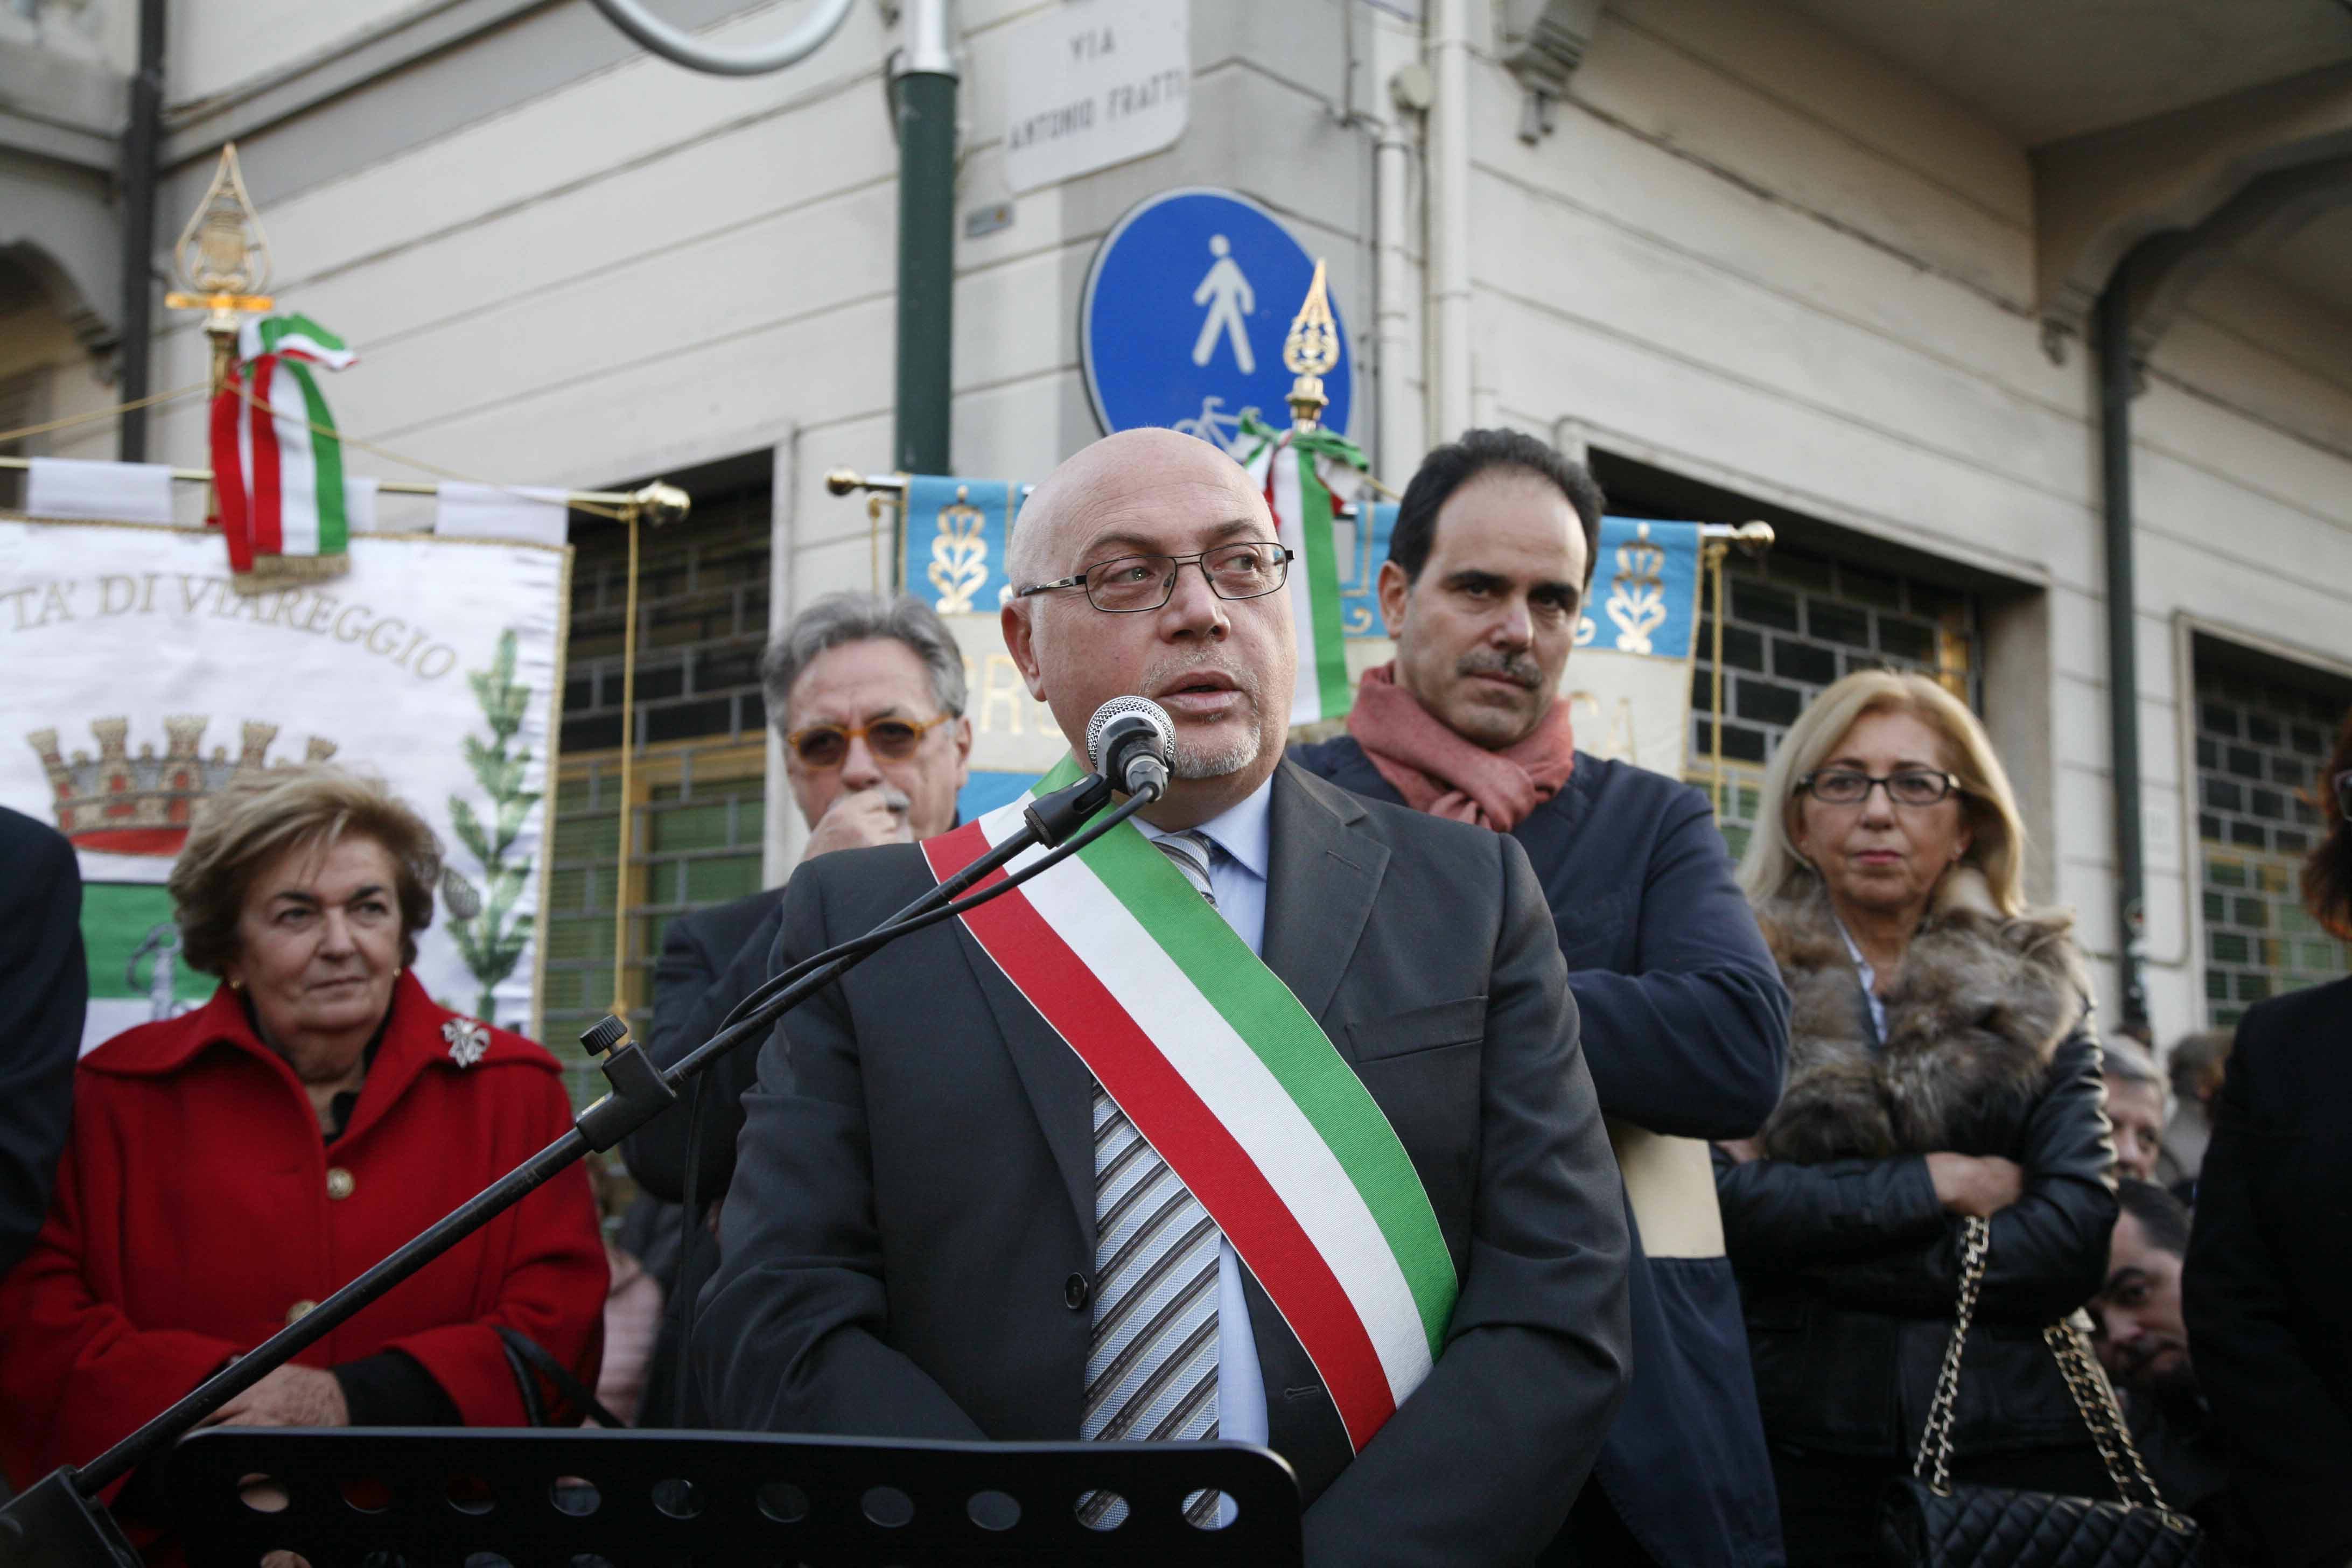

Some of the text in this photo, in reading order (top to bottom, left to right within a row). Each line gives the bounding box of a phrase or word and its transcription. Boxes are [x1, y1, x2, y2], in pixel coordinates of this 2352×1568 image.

[1068, 25, 1116, 62] VIA
[1010, 97, 1095, 150] ANTONIO
[97, 573, 162, 617] DI
[177, 573, 458, 680] VIAREGGIO
